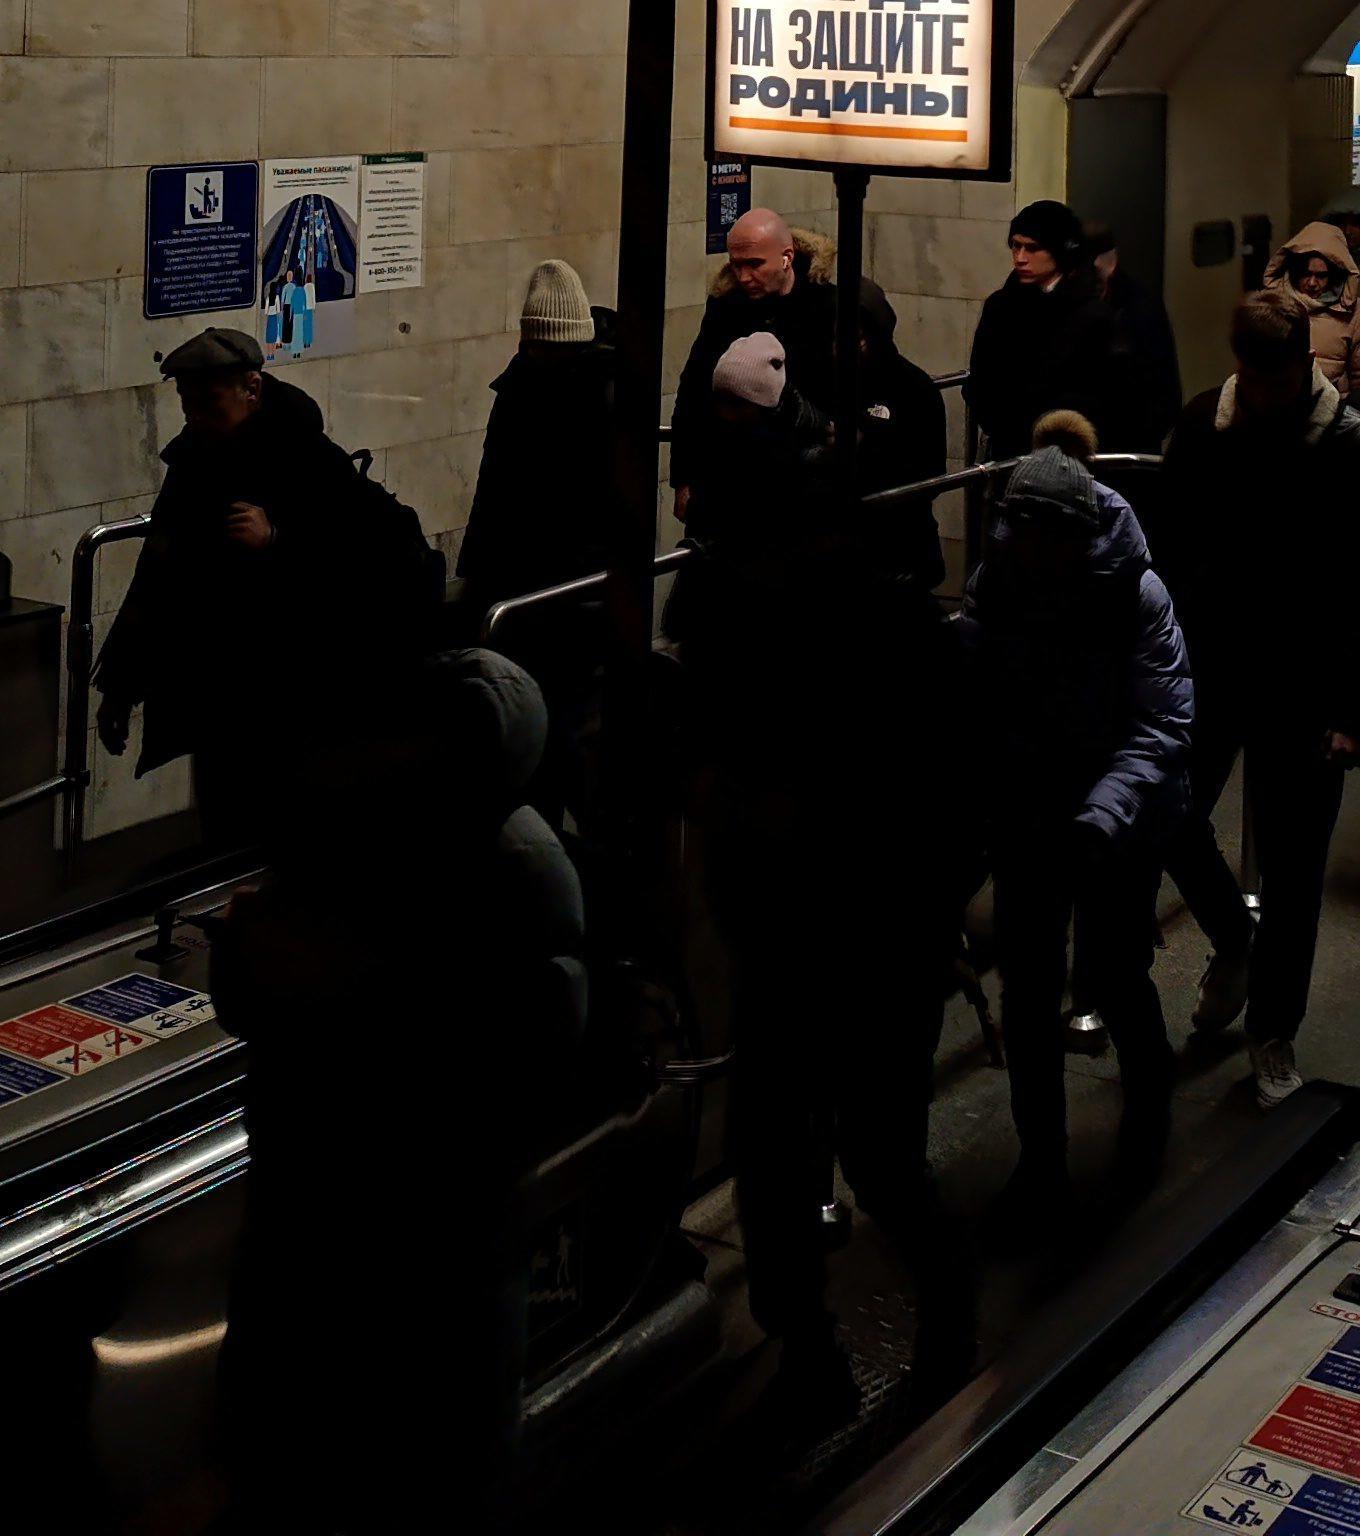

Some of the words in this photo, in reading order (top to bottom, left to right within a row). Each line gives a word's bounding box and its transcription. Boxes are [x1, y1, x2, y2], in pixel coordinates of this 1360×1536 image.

[731, 7, 774, 68] НА
[789, 9, 969, 81] ЗАЩИТЕ
[729, 73, 969, 119] РОДИНЫ
[718, 163, 742, 174] МЕТРО
